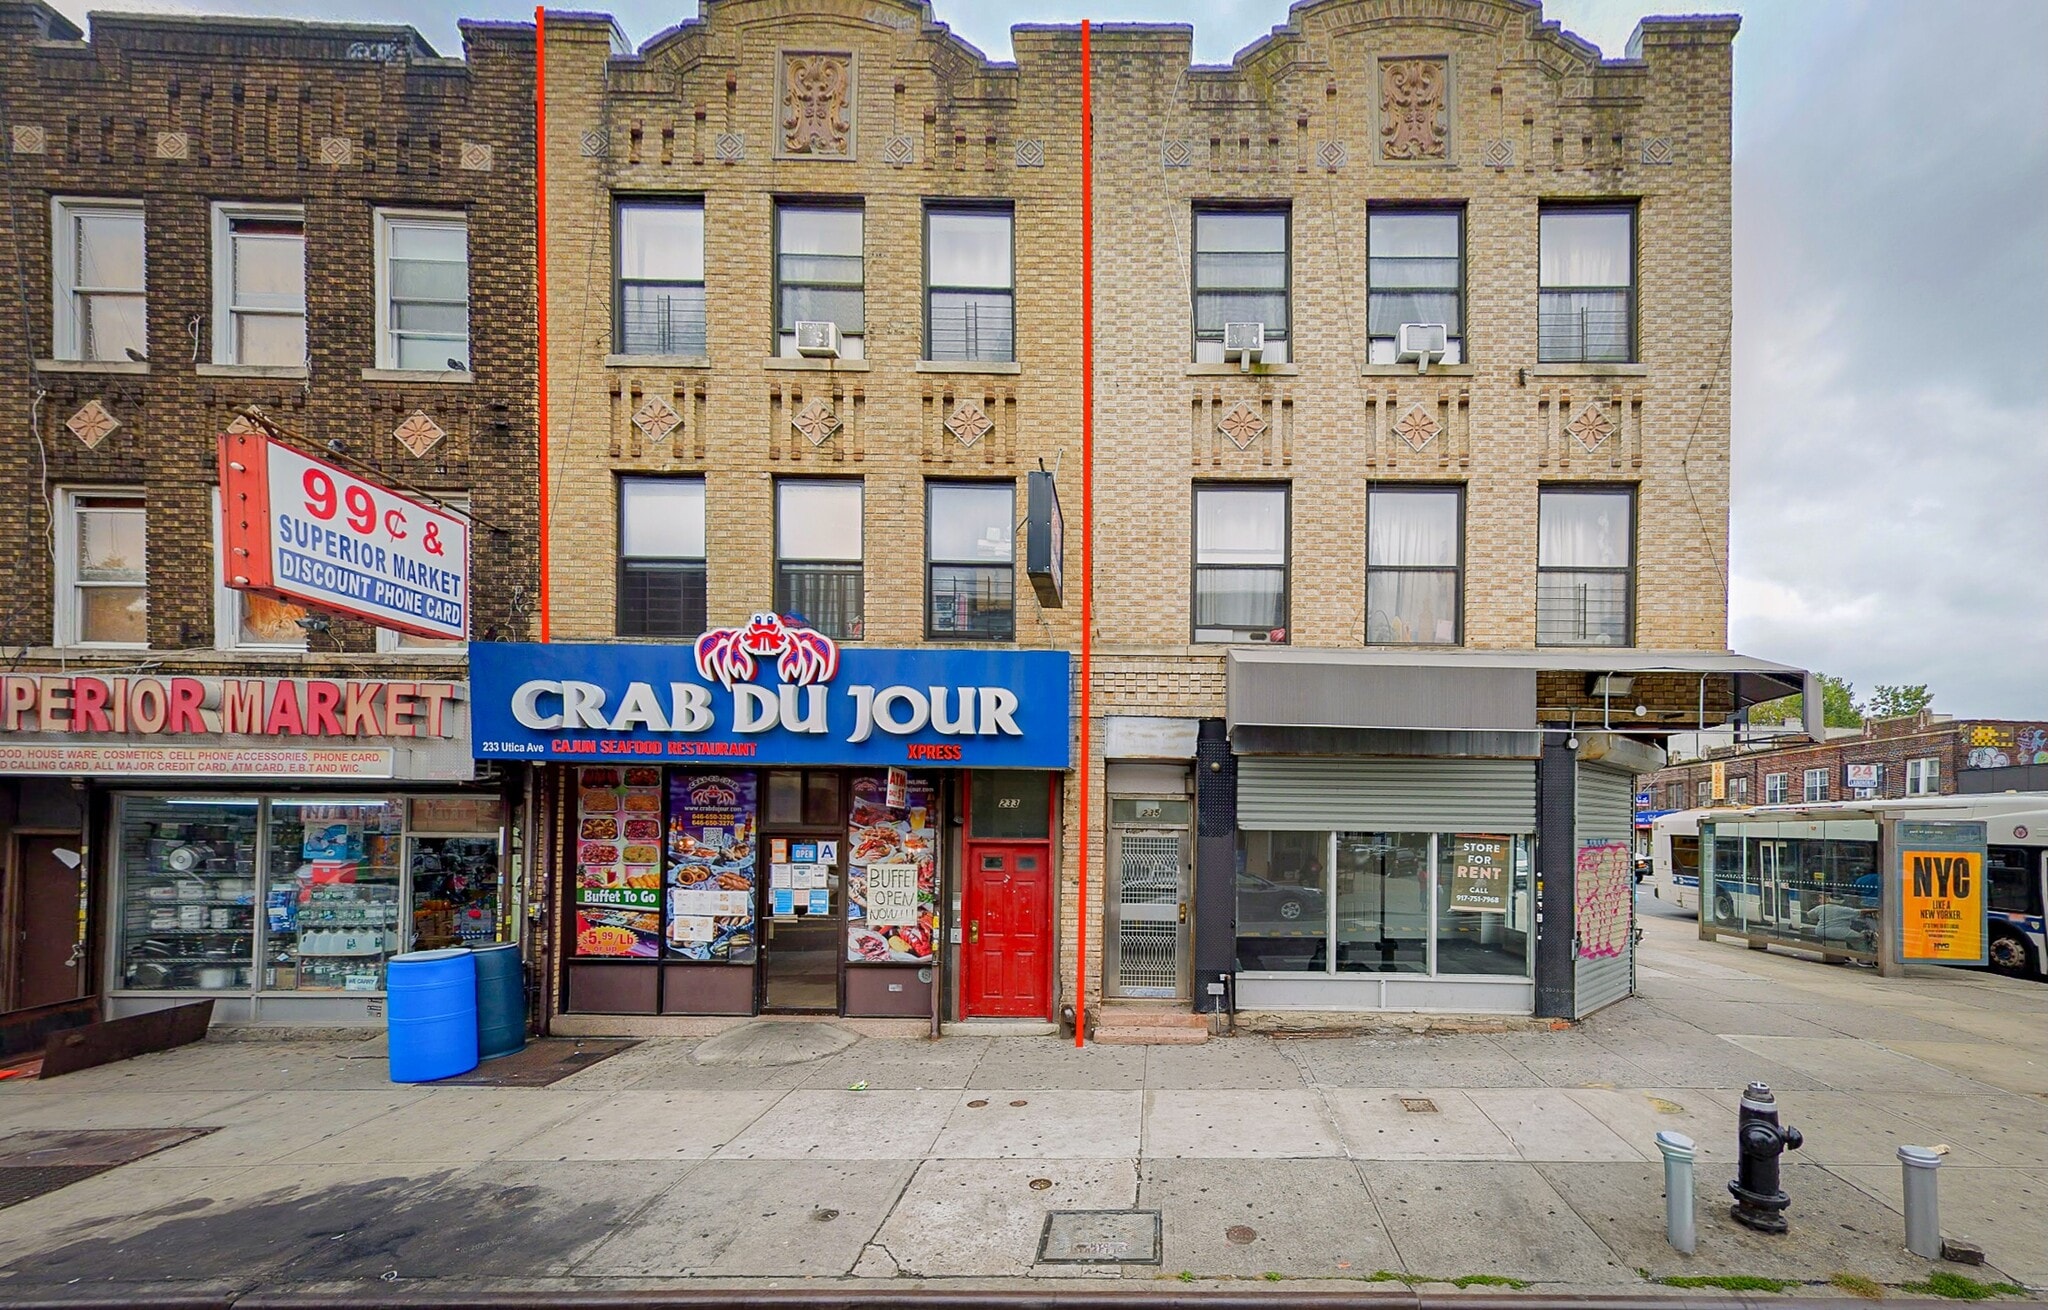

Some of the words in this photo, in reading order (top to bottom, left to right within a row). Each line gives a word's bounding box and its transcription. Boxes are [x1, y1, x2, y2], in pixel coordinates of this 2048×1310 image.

[423, 521, 445, 557] &
[280, 513, 387, 575] SUPERIOR
[393, 553, 461, 598] MARKET
[282, 552, 371, 598] DISCOUNT
[375, 584, 423, 614] PHONE
[426, 601, 461, 626] CARD
[0, 676, 208, 733] PERIOR
[222, 680, 454, 737] MARKET
[511, 679, 714, 732] CRAB
[730, 683, 829, 734] DU
[846, 685, 1024, 743] JOUR
[28, 749, 64, 759] HOUSE
[66, 749, 100, 760] WARE,
[169, 751, 195, 760] CELL
[198, 751, 233, 761] PHONE
[236, 752, 311, 763] ACCESSORIES,
[313, 752, 348, 762] PHONE
[351, 753, 382, 764] CARD,
[482, 742, 499, 752] 233
[501, 742, 525, 752] Utica
[526, 742, 544, 752] Ave
[551, 739, 597, 755] CAJUN
[600, 740, 662, 755] SEAFOOD
[667, 741, 758, 757] RESTAURANT
[907, 743, 962, 760] XPRESS
[11, 761, 56, 770] CALLING
[61, 761, 91, 771] CARD,
[94, 762, 114, 771] ALL
[116, 762, 154, 771] MAJOR
[157, 762, 195, 772] CREDIT
[198, 762, 229, 773] CARD,
[231, 763, 253, 773] ATM
[255, 763, 287, 774] CARD,
[316, 764, 337, 773] AND
[340, 764, 362, 773] WIC.
[1852, 765, 1873, 778] 24
[999, 799, 1020, 808] 233
[1142, 809, 1161, 817] 235
[796, 850, 813, 858] OPEN
[821, 844, 834, 859] A
[1463, 843, 1500, 853] STORE
[1468, 855, 1492, 865] FOR
[869, 868, 917, 888] BUFFET
[1457, 866, 1502, 880] RENT
[1913, 856, 1970, 899] NYC
[584, 890, 620, 903] Buffet
[624, 890, 638, 903] To
[640, 891, 656, 903] Go
[1469, 886, 1489, 894] CALL
[875, 890, 915, 907] OPEN
[1932, 900, 1945, 909] LIKE
[1946, 900, 1951, 910] A
[1920, 910, 1935, 919] NEW
